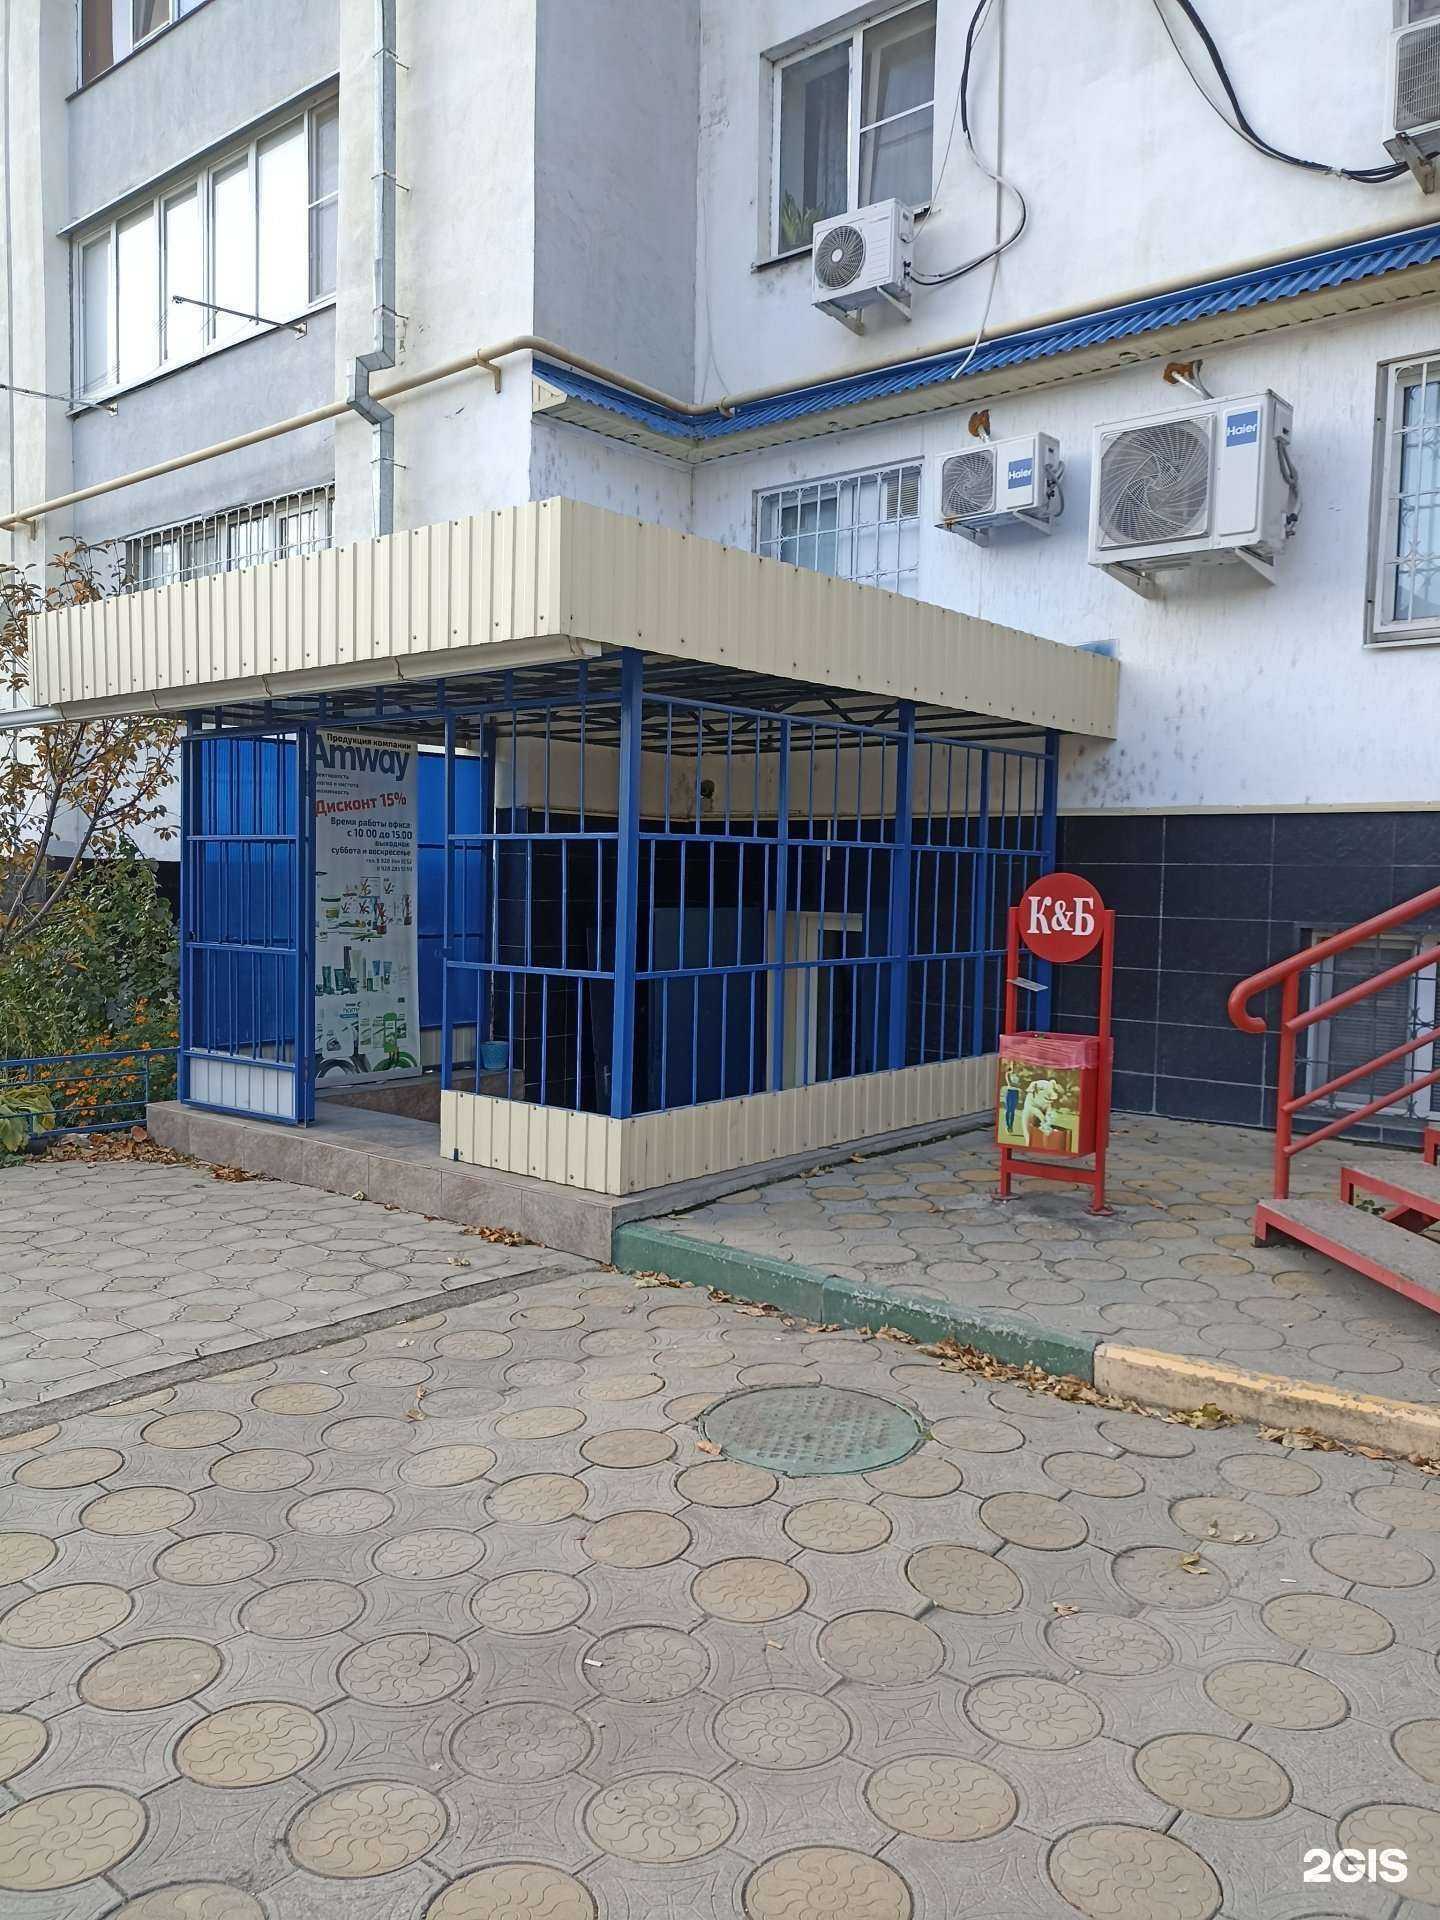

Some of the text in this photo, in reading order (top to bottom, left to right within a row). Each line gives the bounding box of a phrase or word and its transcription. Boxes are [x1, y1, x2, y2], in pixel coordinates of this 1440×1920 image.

[1226, 423, 1258, 436] Haier
[1008, 469, 1032, 480] Haier
[327, 733, 411, 749] Продукция компании
[314, 734, 410, 781] Amway
[315, 792, 407, 817] Дисконт 15%
[331, 817, 357, 826] Время
[359, 819, 386, 828] работы
[331, 846, 360, 855] суббота
[1026, 896, 1095, 936] К&Б
